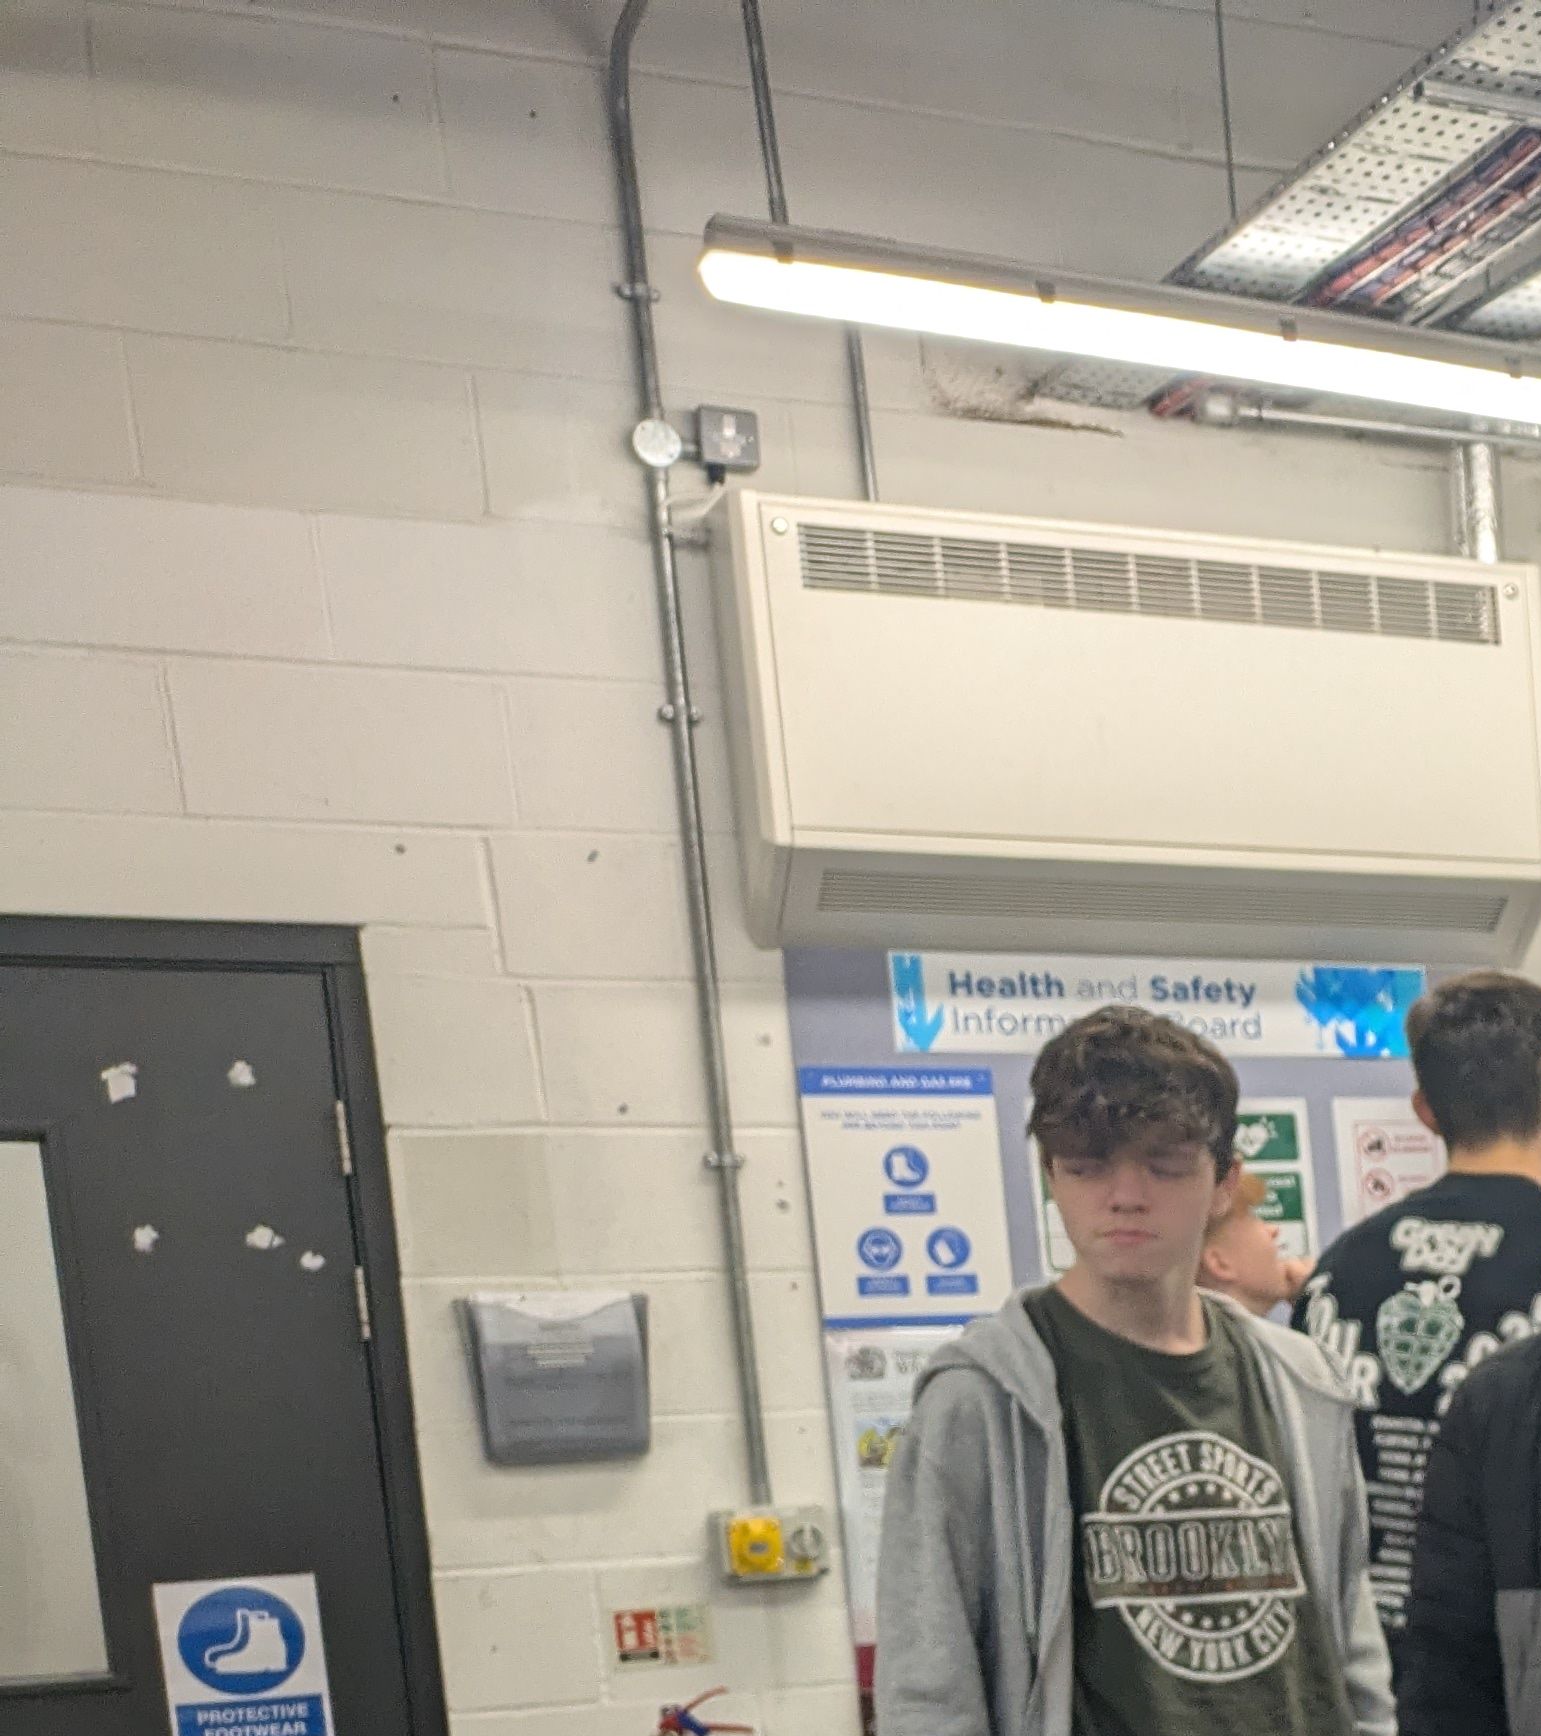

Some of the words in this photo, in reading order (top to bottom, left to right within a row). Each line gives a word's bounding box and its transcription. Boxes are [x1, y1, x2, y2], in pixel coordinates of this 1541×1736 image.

[948, 970, 1066, 999] Health
[1076, 974, 1139, 1000] and
[1150, 974, 1257, 1009] Safety
[952, 1005, 1072, 1037] Inform
[1168, 1009, 1263, 1041] oard
[1111, 1443, 1192, 1512] STREET
[1198, 1441, 1279, 1504] SPORTS
[1084, 1517, 1291, 1585] BROOKLY
[1132, 1605, 1186, 1661] NEW
[1187, 1638, 1256, 1672] YORK
[1248, 1598, 1294, 1657] CITY
[196, 1701, 310, 1726] PROTECTIVE
